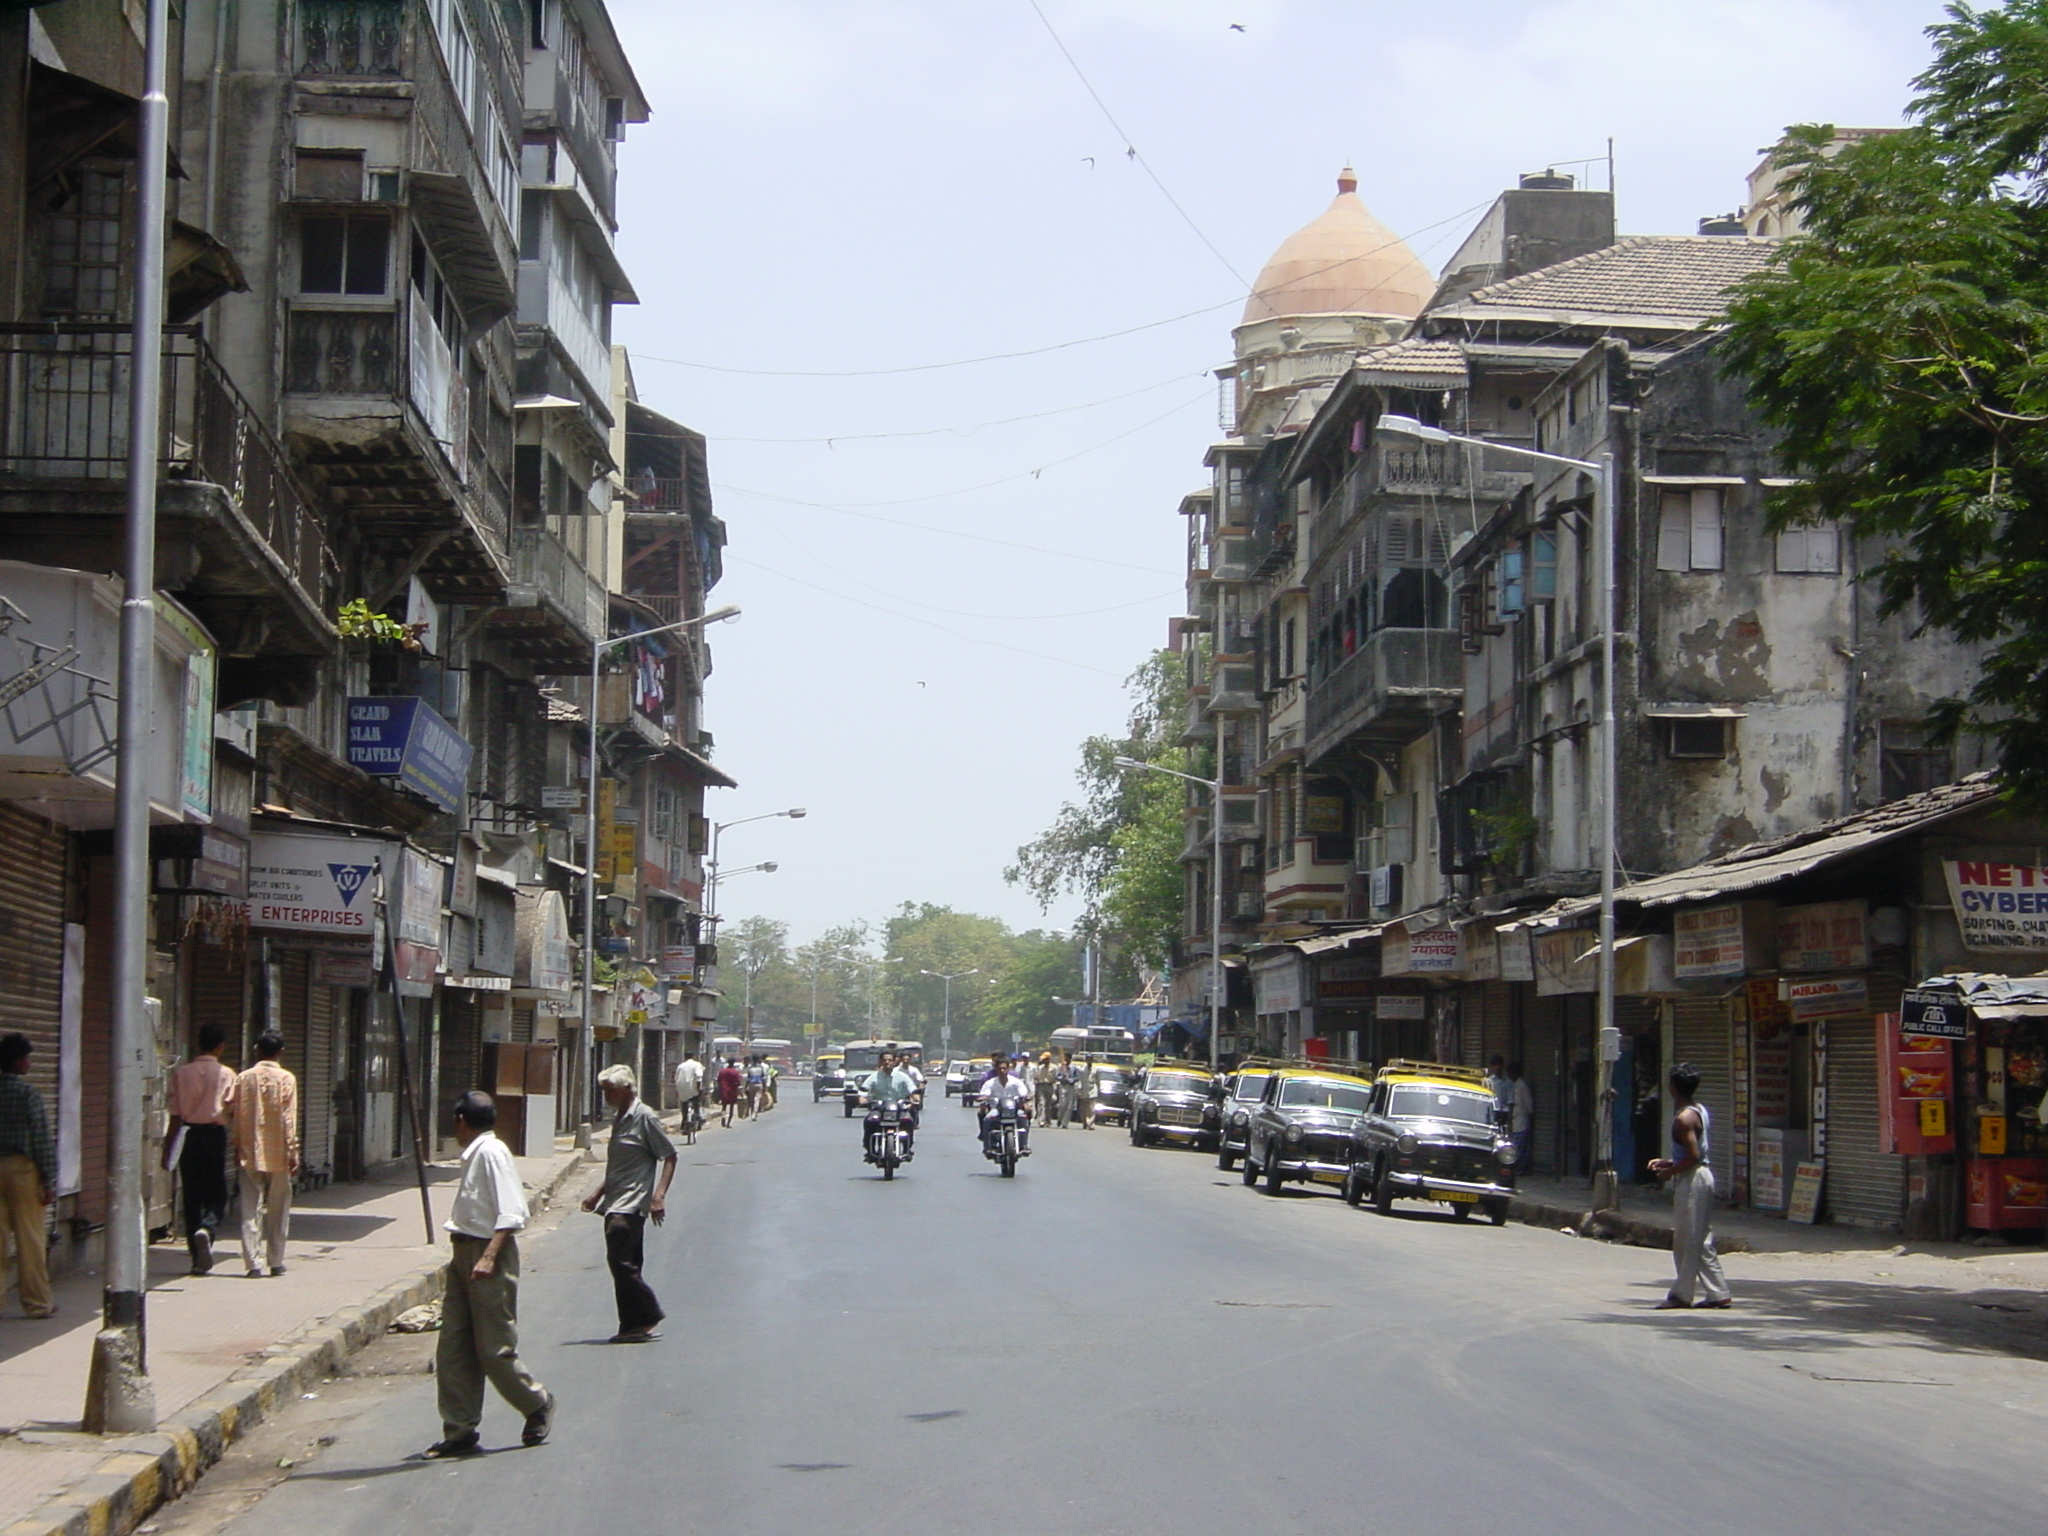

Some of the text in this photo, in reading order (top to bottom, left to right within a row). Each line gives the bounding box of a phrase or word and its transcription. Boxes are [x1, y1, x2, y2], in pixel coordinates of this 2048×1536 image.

[350, 705, 390, 720] GRAND
[350, 726, 381, 741] SLAM
[350, 747, 401, 762] TRAVELS
[1957, 861, 2048, 888] NET
[261, 905, 364, 926] ENTERPRISES
[1791, 983, 1839, 998] MIRANDA
[1903, 1021, 1965, 1035] PUBLIC CALL OFFICE
